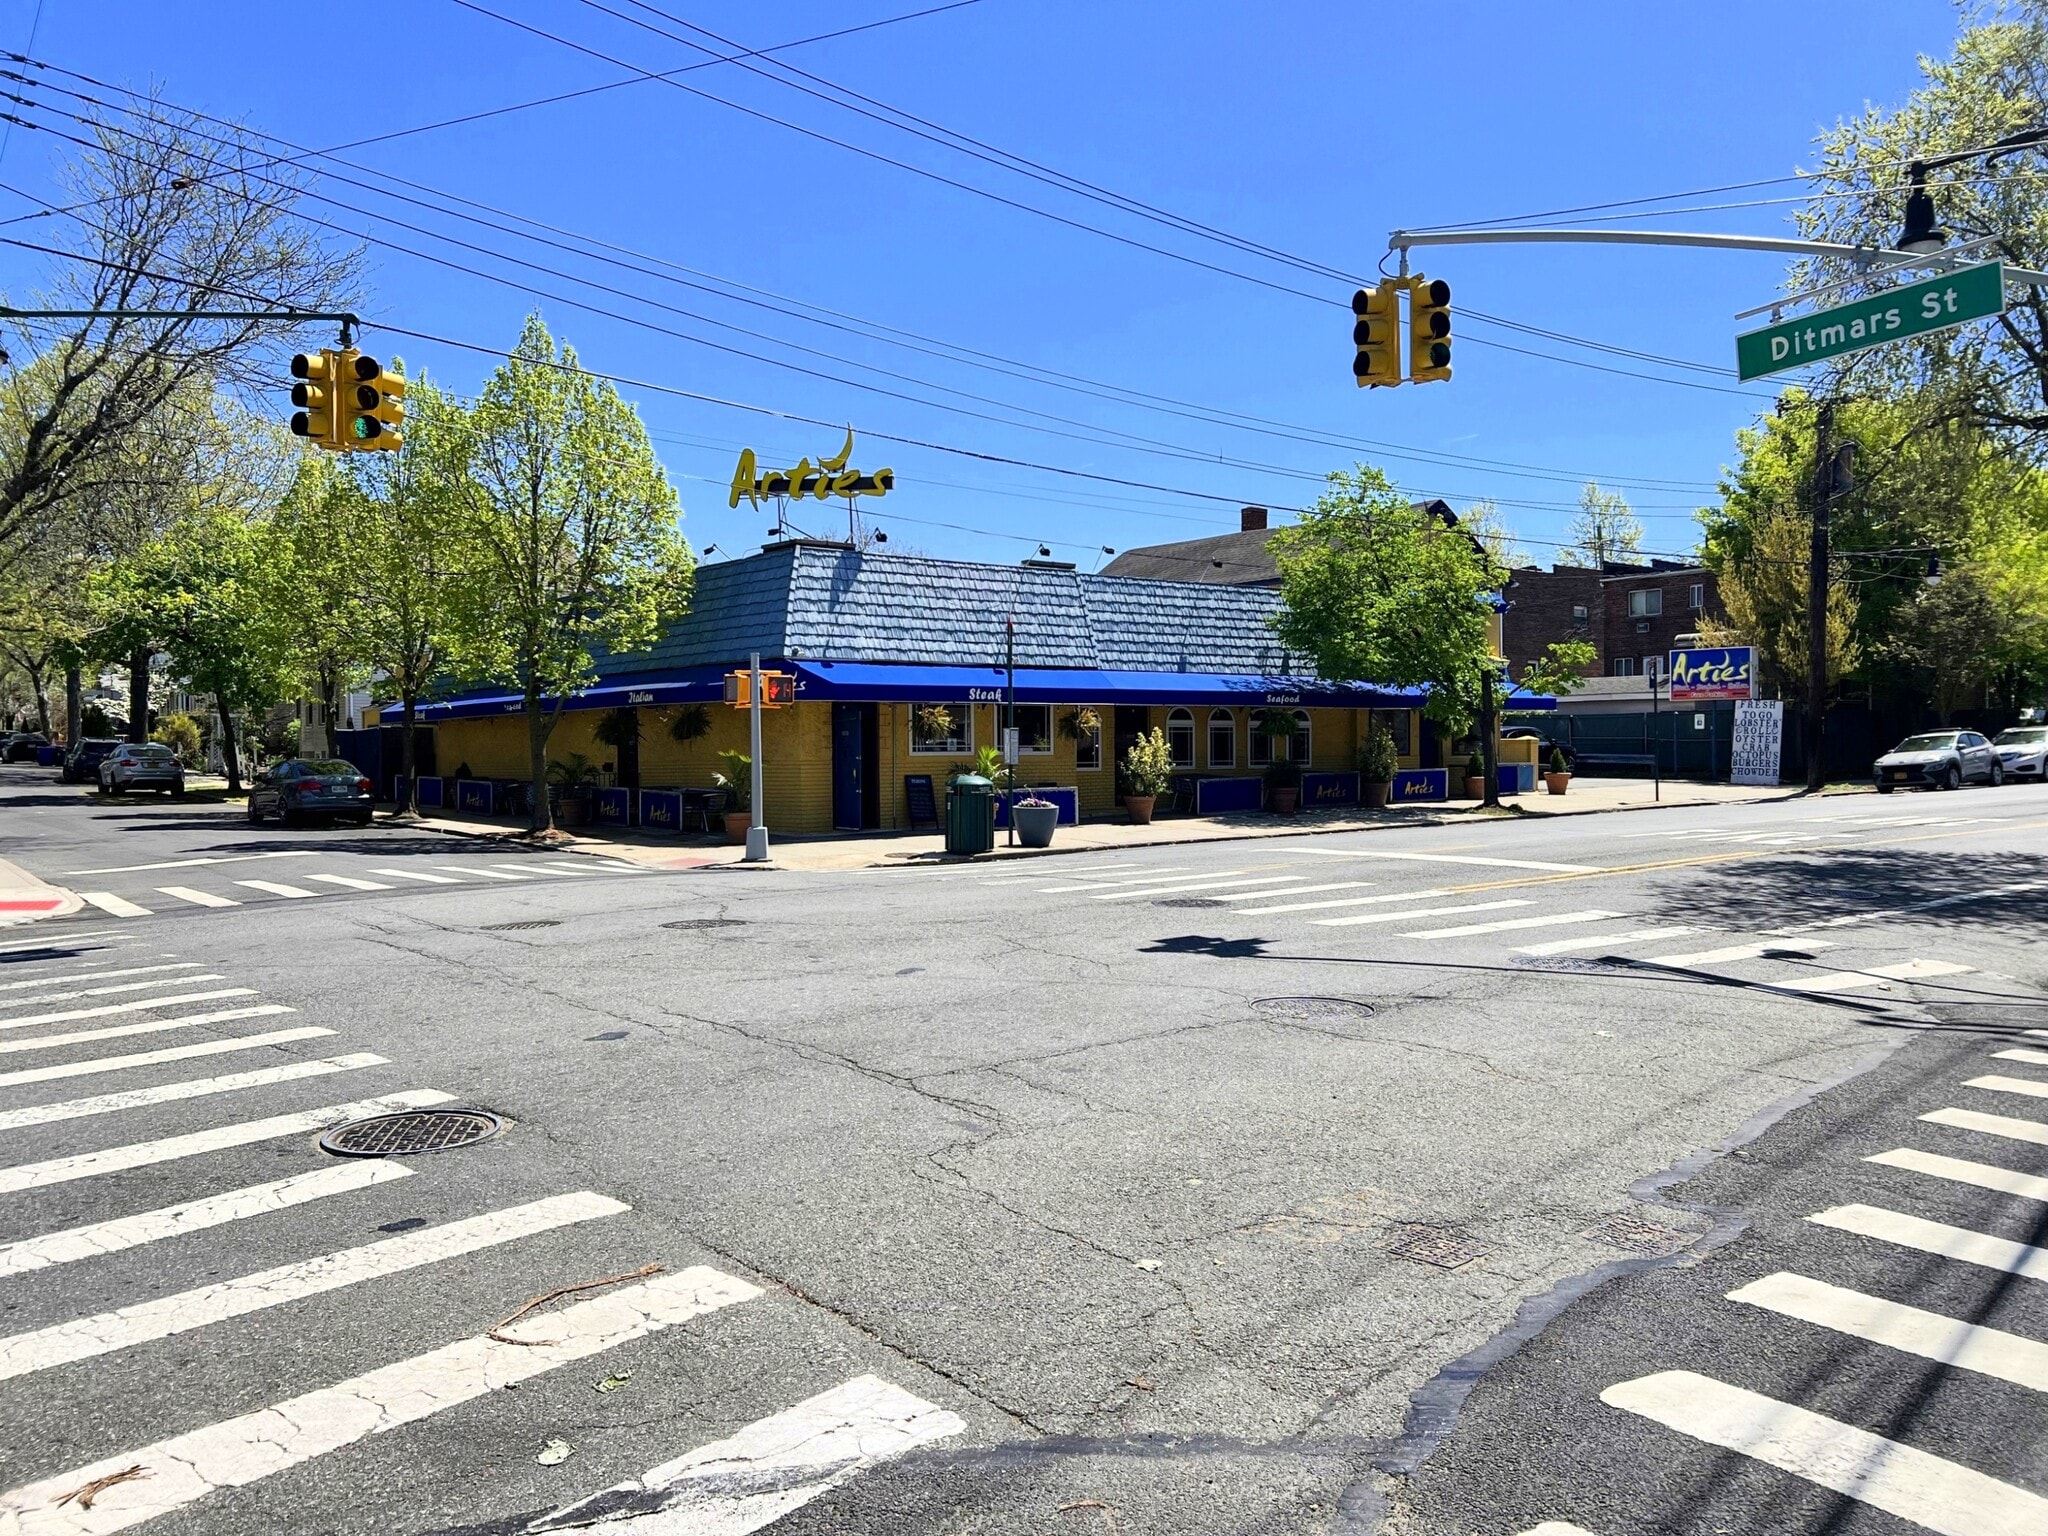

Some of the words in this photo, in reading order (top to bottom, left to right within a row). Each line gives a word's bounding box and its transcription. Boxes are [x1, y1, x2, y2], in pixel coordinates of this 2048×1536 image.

[1771, 308, 1901, 362] Ditmars
[1921, 287, 1958, 319] St
[729, 421, 894, 513] Arties
[1672, 650, 1749, 688] Arties
[628, 691, 654, 703] Italian
[969, 688, 1002, 702] Steak
[1266, 694, 1300, 704] Seafood
[1740, 700, 1776, 709] FRESH
[1743, 711, 1756, 719] TO
[1759, 711, 1772, 720] GO
[1735, 735, 1778, 744] OYSTER
[1742, 743, 1770, 752] CRAB
[1732, 751, 1779, 760] OCTOPUS
[1732, 759, 1778, 767] BURGERS
[1731, 767, 1778, 776] CHOWDER
[1404, 776, 1434, 795] Arties
[650, 801, 671, 822] Arties
